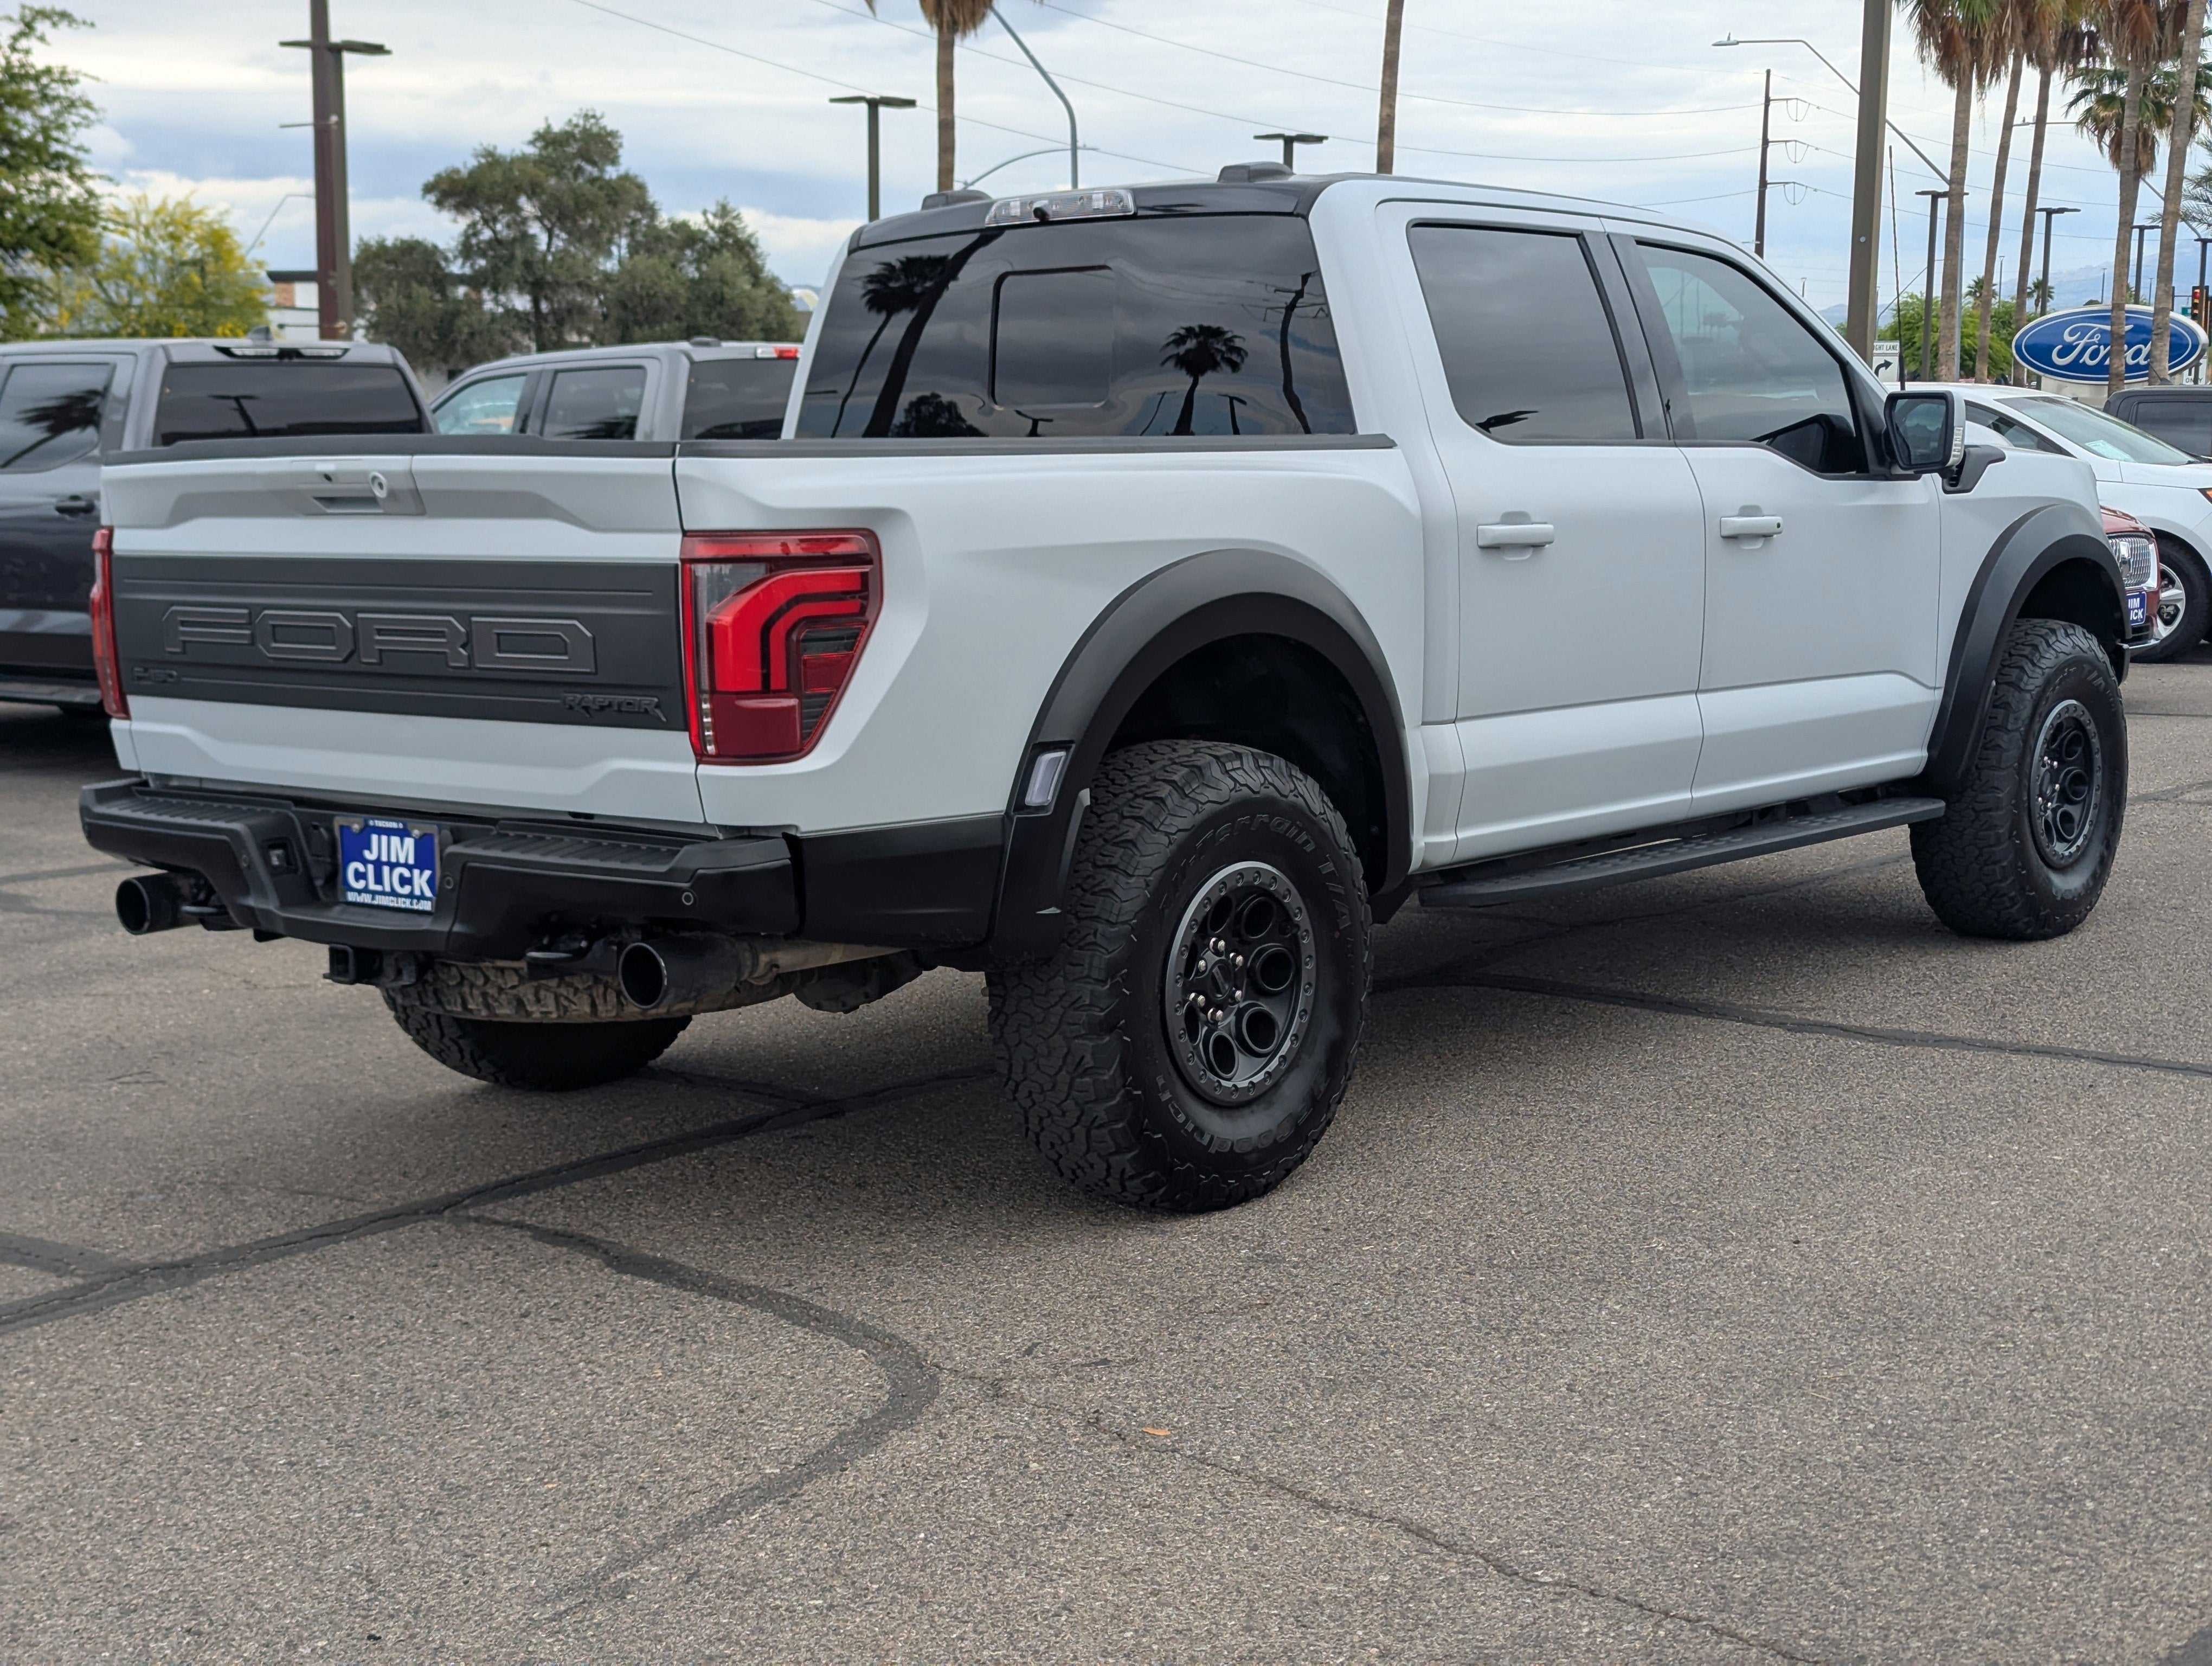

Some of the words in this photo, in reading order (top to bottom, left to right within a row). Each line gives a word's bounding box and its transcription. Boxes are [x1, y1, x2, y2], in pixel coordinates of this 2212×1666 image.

[162, 606, 598, 675] FORD
[563, 692, 667, 723] RAPTOR
[374, 819, 398, 829] TUCSON
[362, 833, 415, 866] JIM
[346, 861, 434, 898] CLICK
[346, 890, 433, 911] WWW.JIMCLICK.COM
